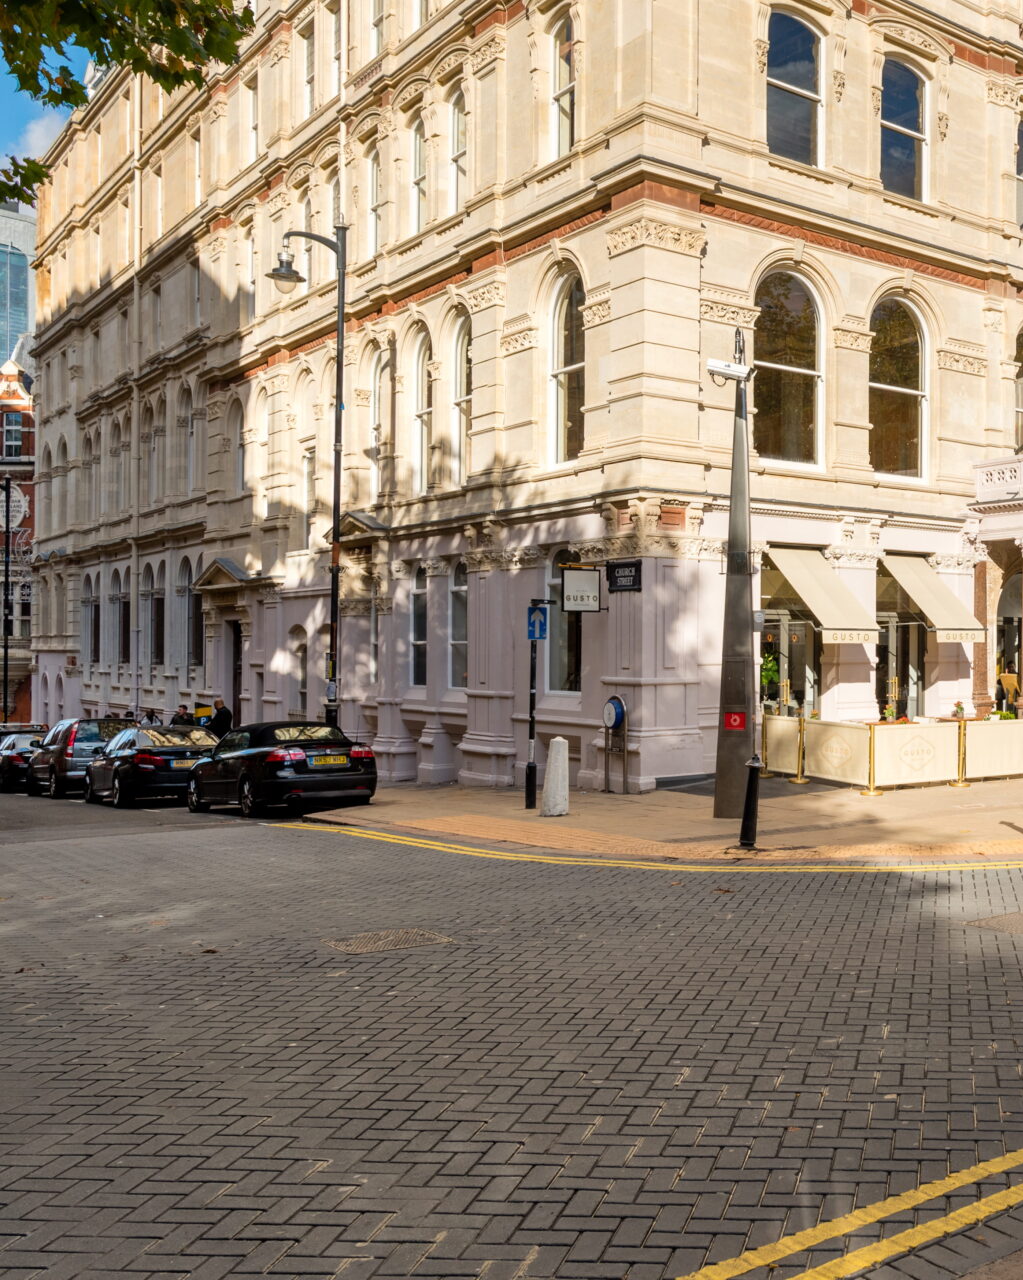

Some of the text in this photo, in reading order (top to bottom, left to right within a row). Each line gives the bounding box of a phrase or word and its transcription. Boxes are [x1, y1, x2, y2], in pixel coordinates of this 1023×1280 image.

[615, 567, 635, 577] CHURCH
[617, 577, 633, 585] STREET
[832, 632, 870, 641] GUSTO
[945, 632, 976, 641] GUSTO
[903, 748, 932, 756] GUSTO
